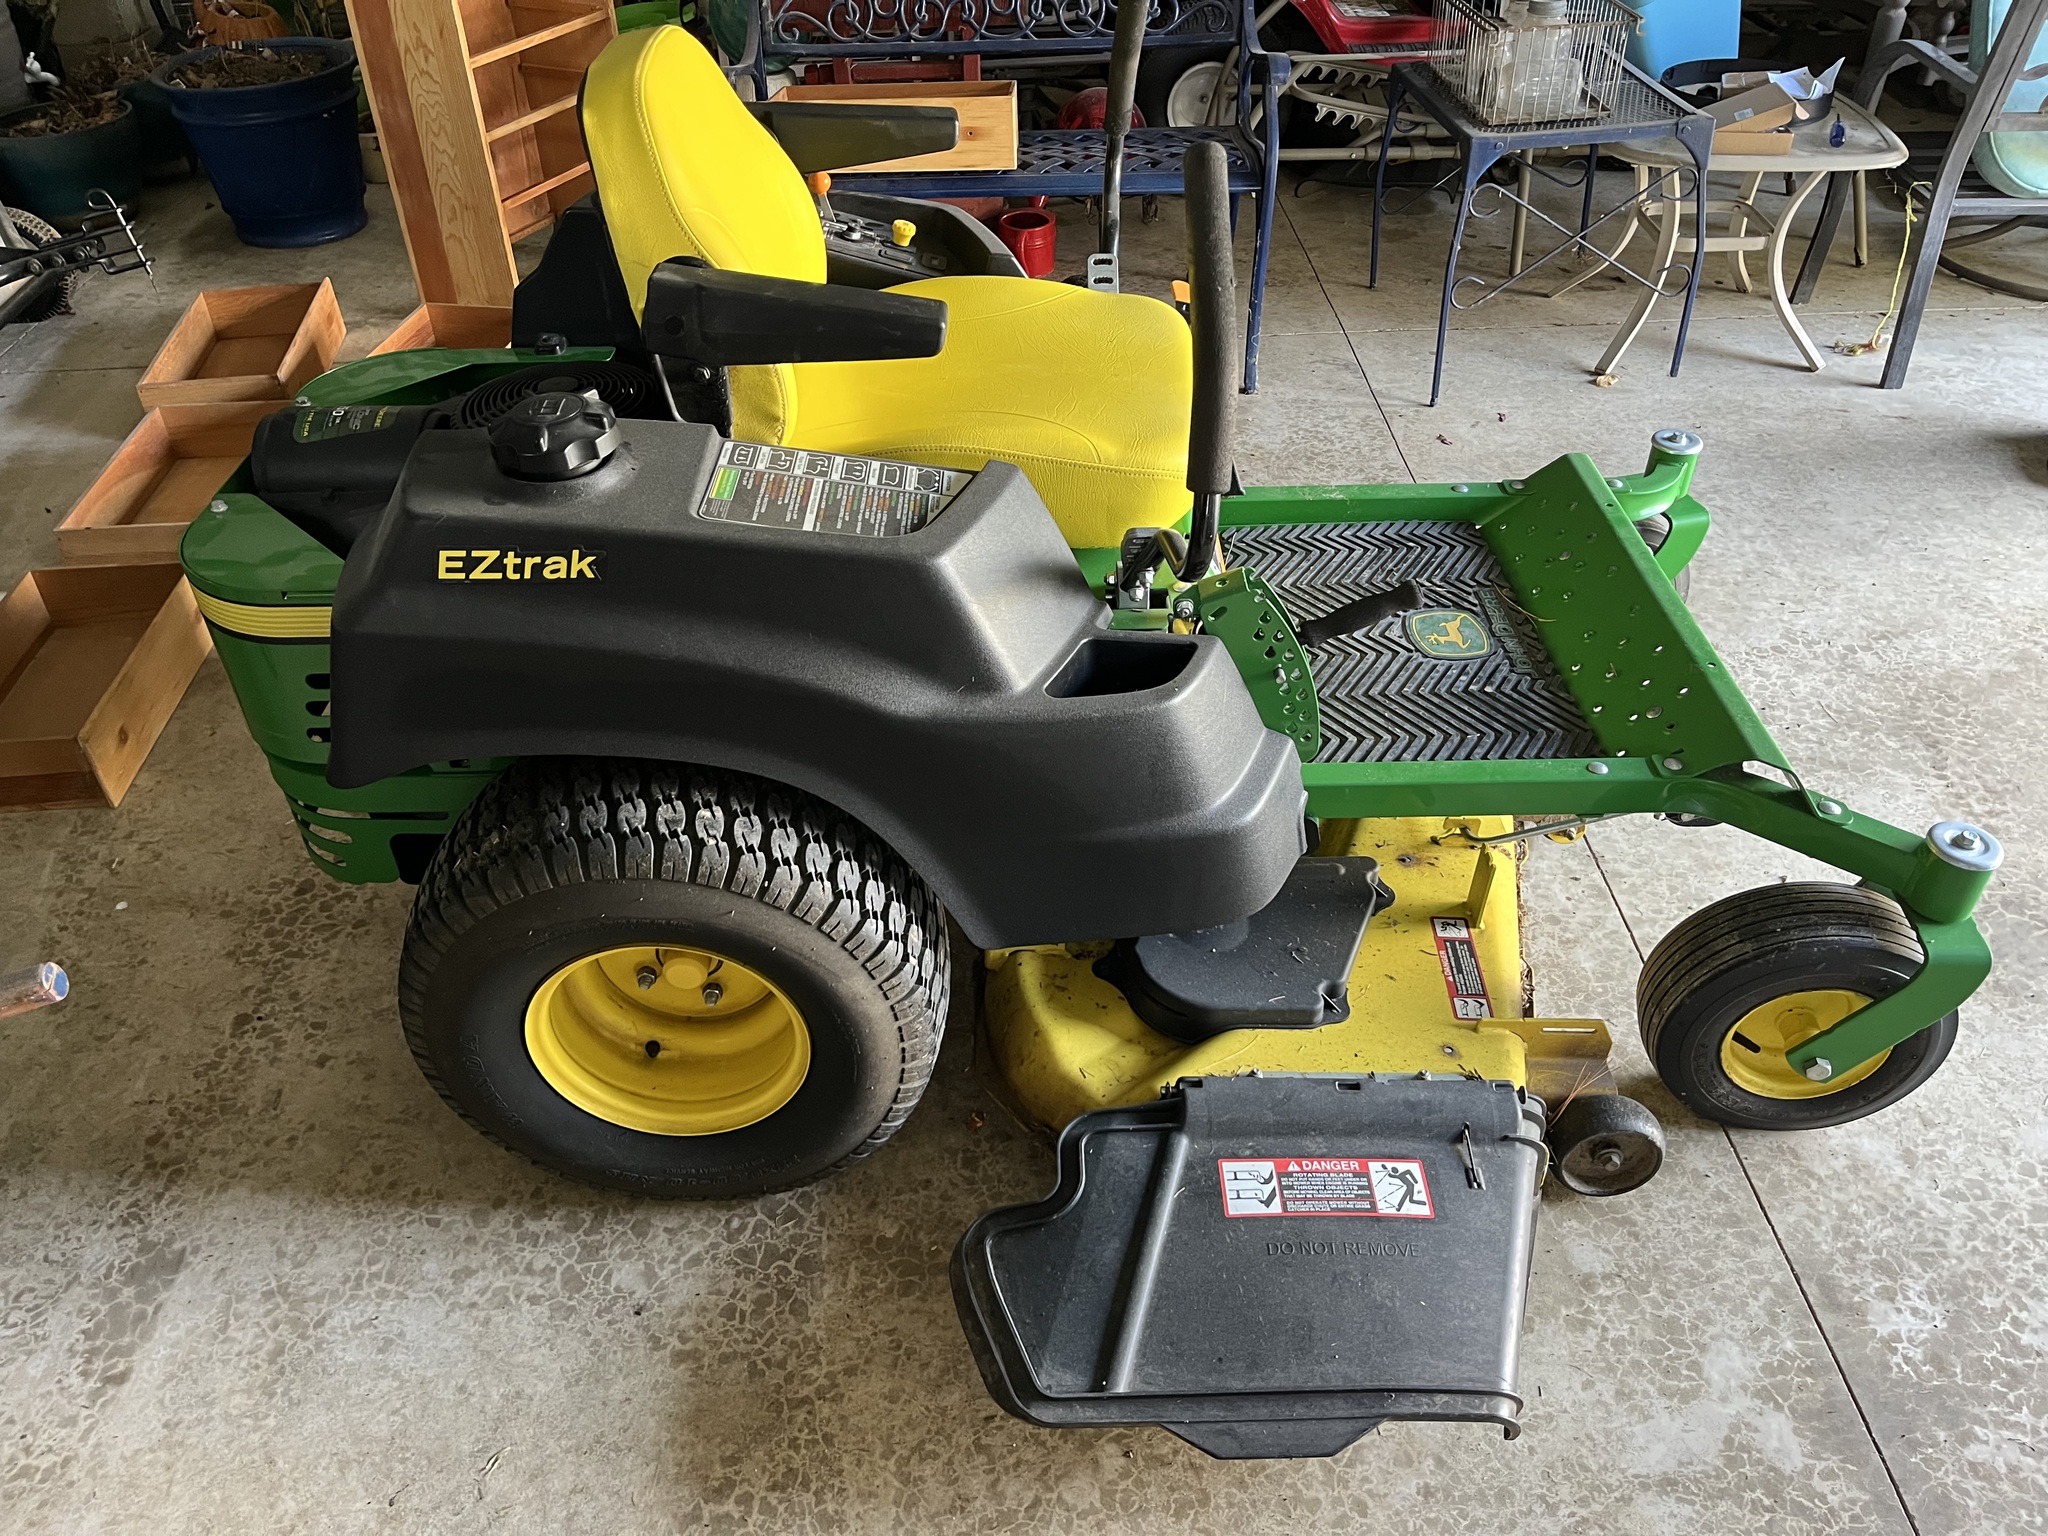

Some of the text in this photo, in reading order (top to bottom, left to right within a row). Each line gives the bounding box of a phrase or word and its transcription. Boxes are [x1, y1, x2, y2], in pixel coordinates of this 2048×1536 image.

[302, 422, 311, 437] USA
[438, 549, 597, 580] EZtrak
[1440, 950, 1453, 976] DANGER
[1302, 1160, 1360, 1170] DANGER
[1267, 1241, 1420, 1257] DO NOT REMOVE
